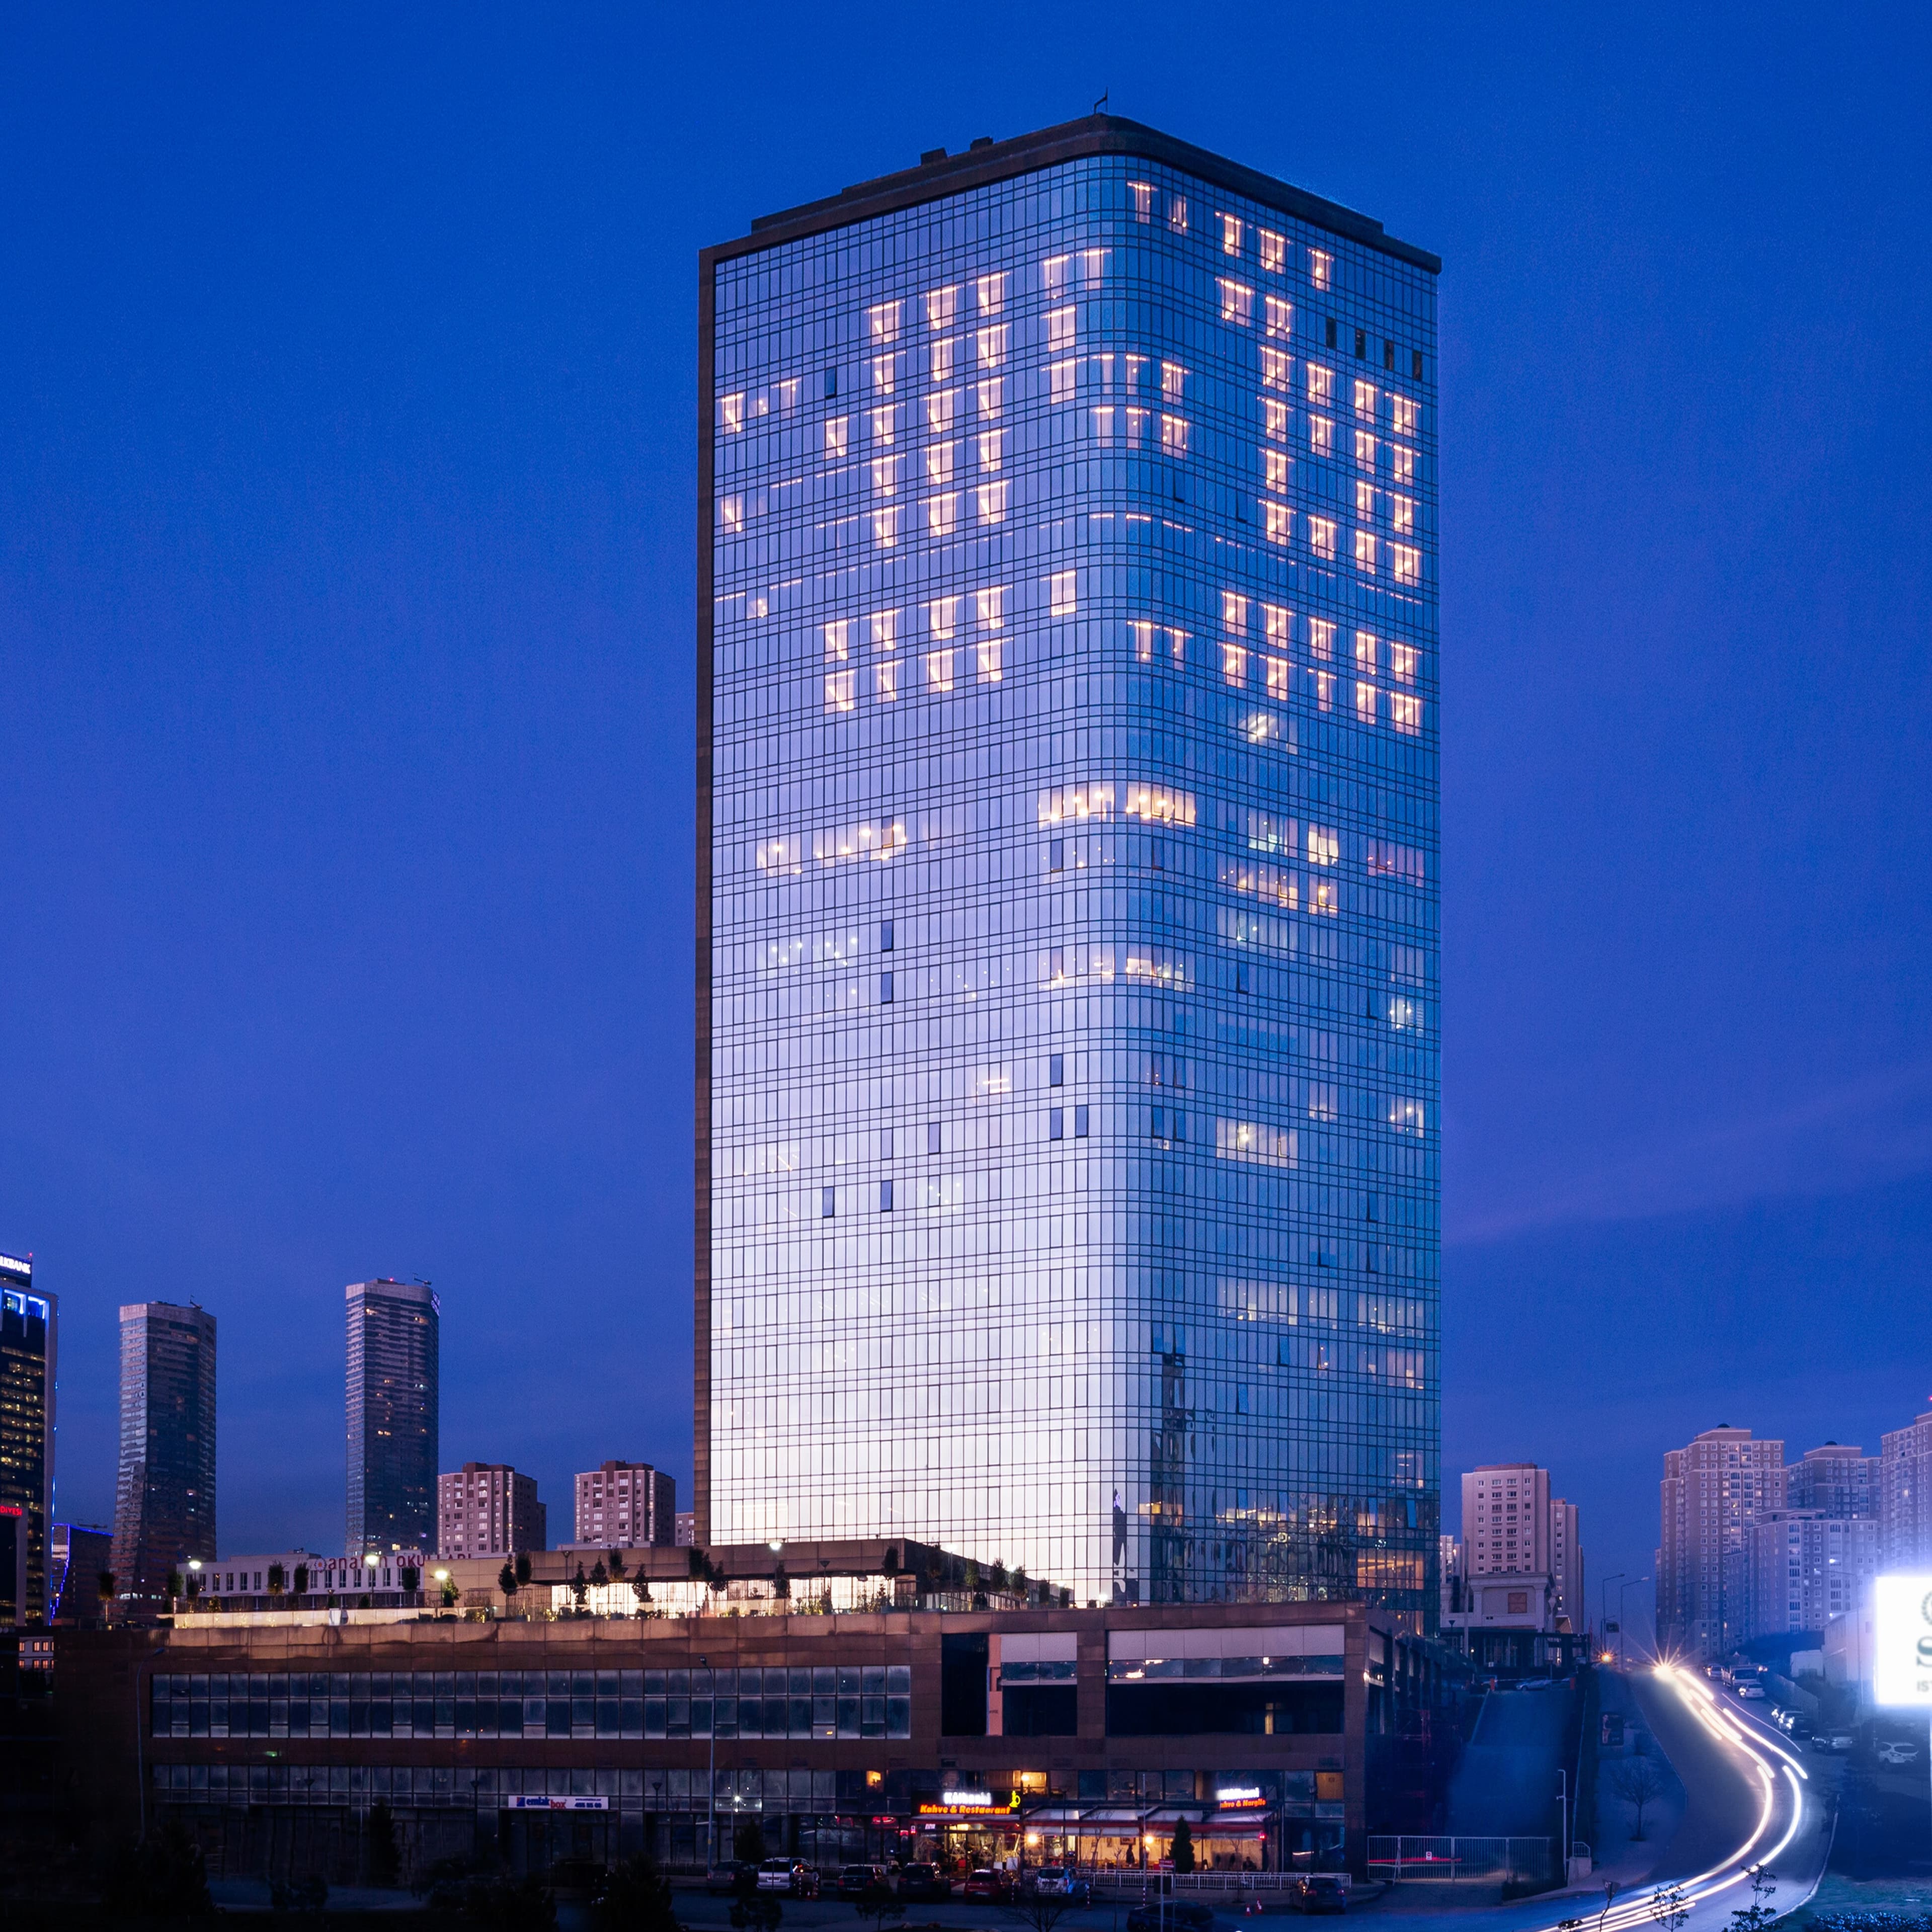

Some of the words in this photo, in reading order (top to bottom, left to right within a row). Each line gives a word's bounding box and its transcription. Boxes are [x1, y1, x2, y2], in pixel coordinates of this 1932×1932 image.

[328, 1554, 387, 1570] anafn
[550, 1800, 567, 1809] box
[920, 1804, 948, 1814] Kahve
[950, 1805, 957, 1814] &
[959, 1805, 1011, 1814] Restaurant
